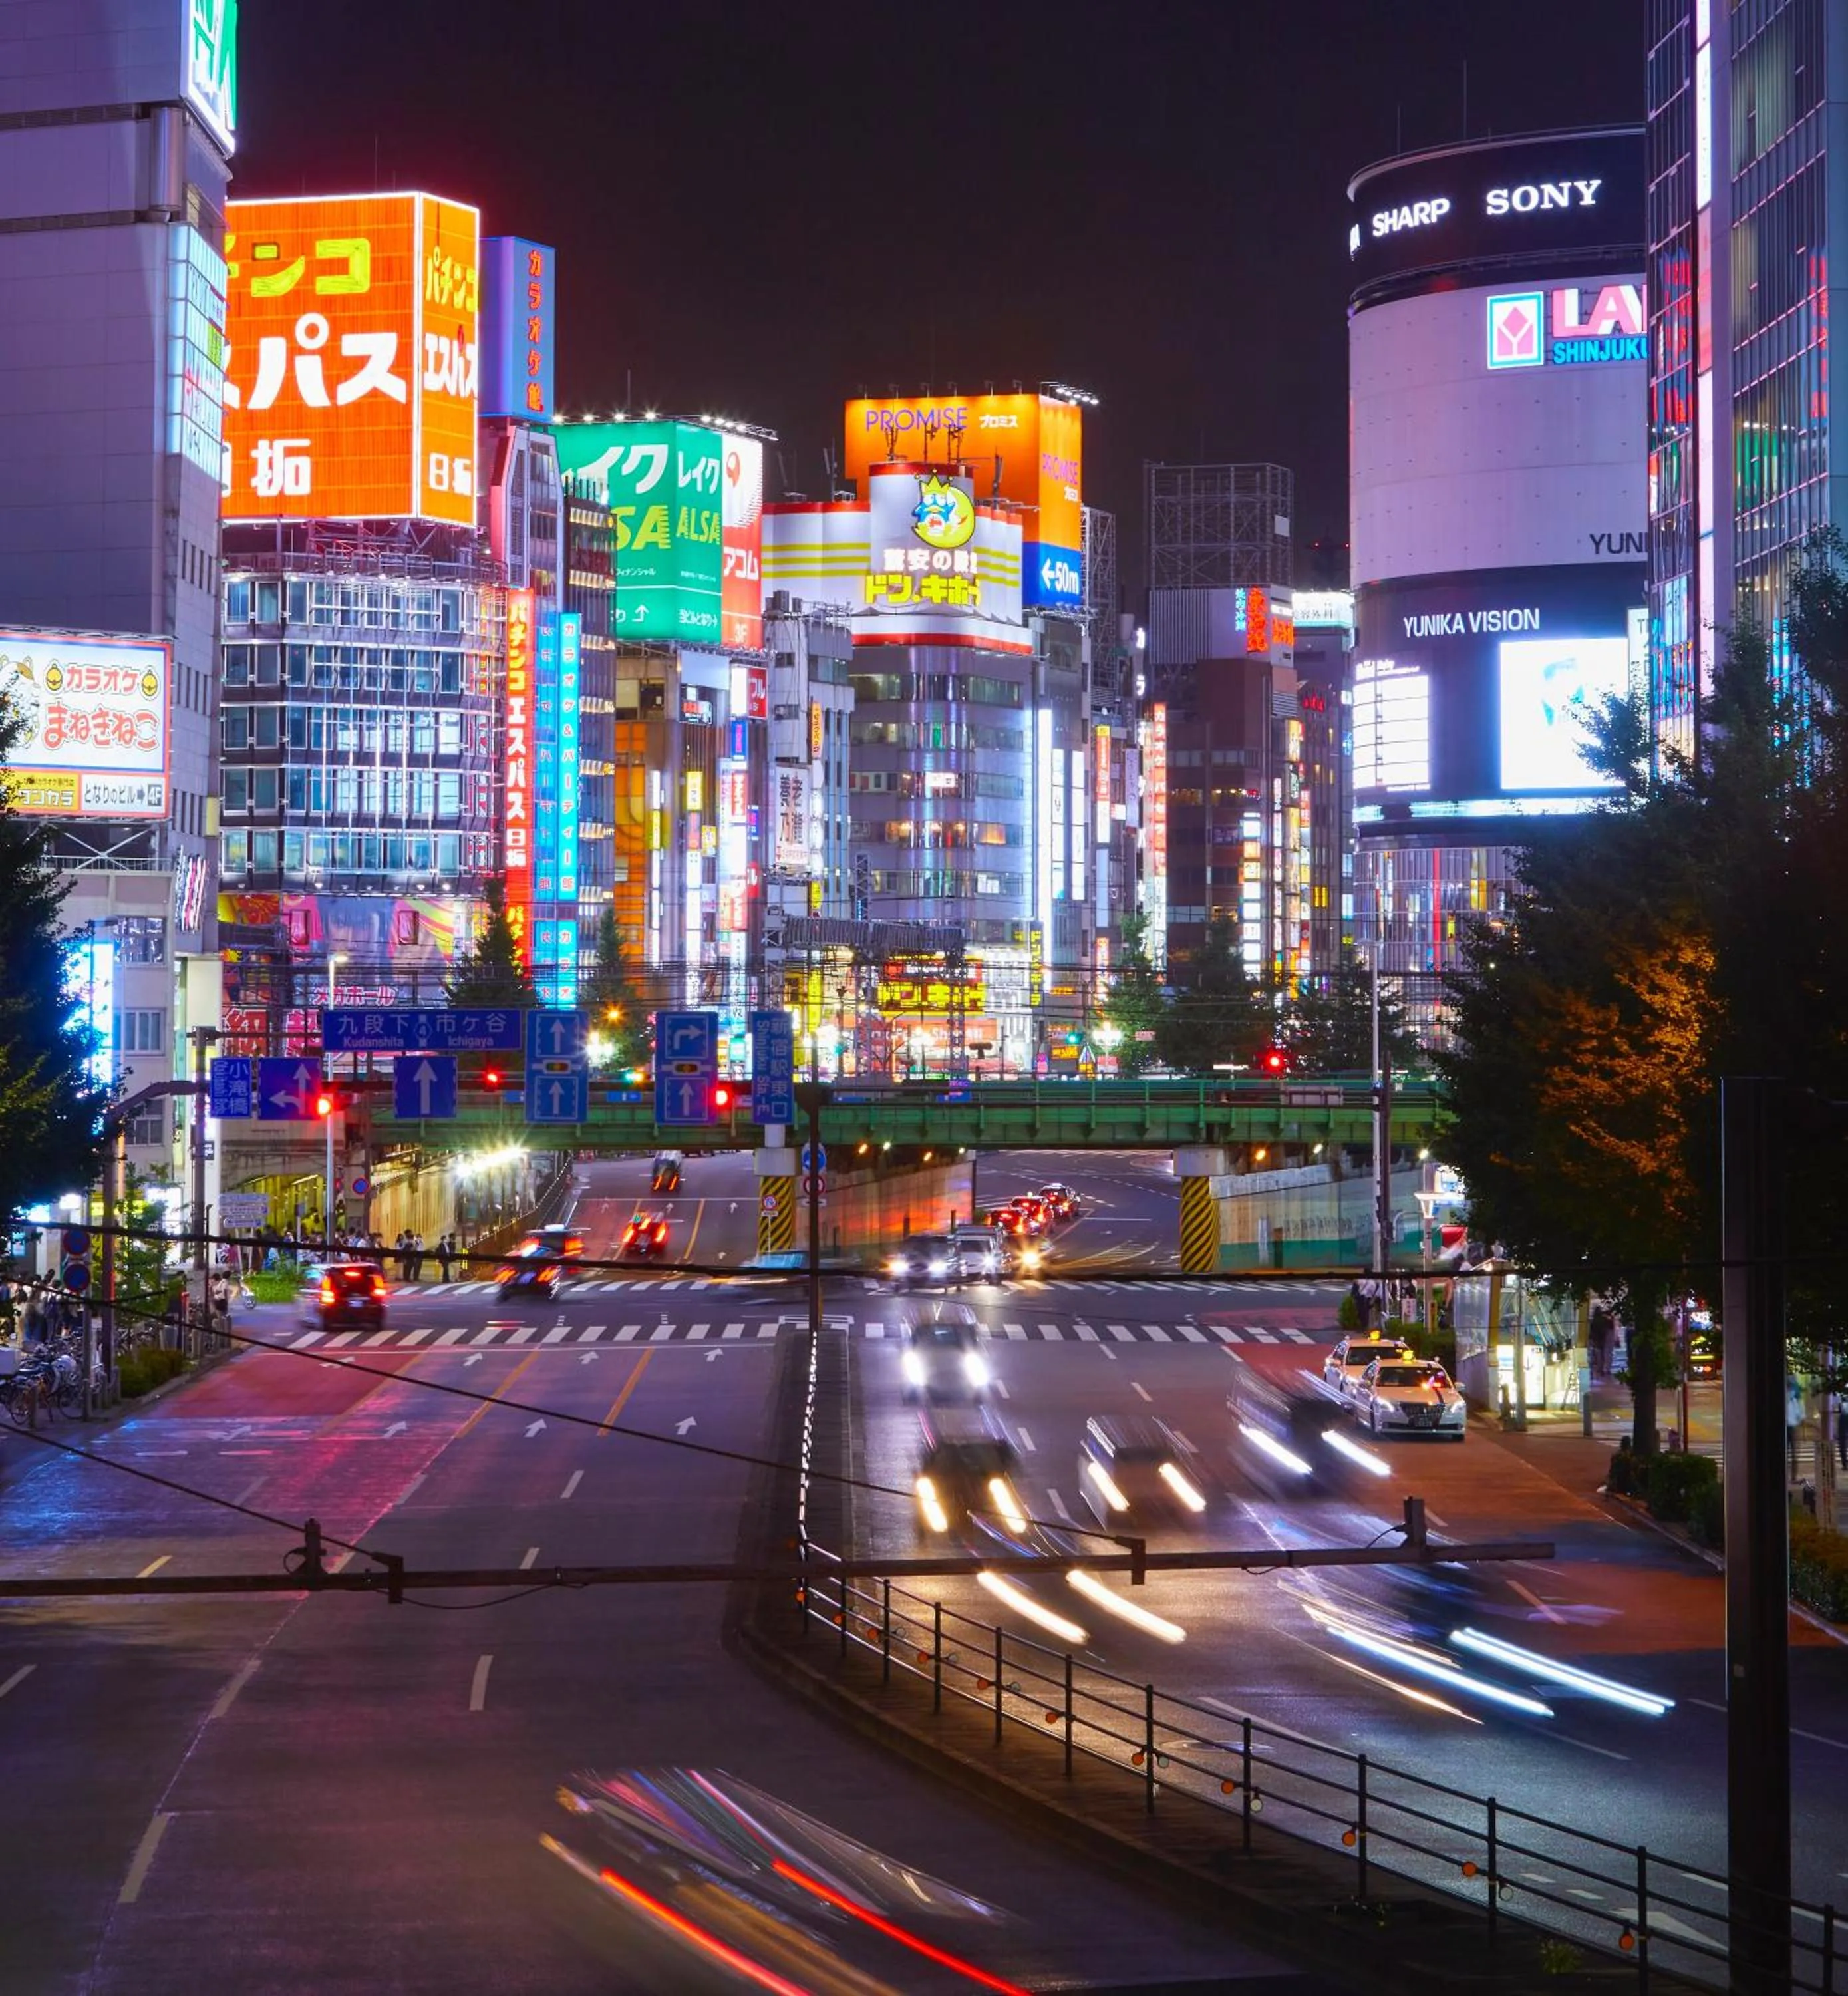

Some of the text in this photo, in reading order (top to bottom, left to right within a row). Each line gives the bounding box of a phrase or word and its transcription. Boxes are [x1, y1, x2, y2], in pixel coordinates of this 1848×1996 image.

[1372, 179, 1602, 237] SHARP SONY
[425, 245, 477, 313] パチンコ
[1551, 284, 1648, 337] LA
[424, 325, 477, 397] エスパス
[865, 407, 969, 432] PROMISE
[979, 415, 1020, 429] プロミス
[677, 450, 721, 494] レイク
[1042, 452, 1078, 486] PROMISE
[675, 506, 720, 545] ALSA
[724, 545, 759, 582] アコム
[1054, 560, 1080, 595] 50m
[1404, 608, 1541, 638] YUNIKA VISION
[508, 600, 527, 691] パチンコ
[66, 665, 140, 693] カラオケ
[43, 703, 159, 749] まねきねこ
[84, 784, 162, 806] となりのビル 4F
[507, 697, 527, 868] エスパス日拓
[338, 1013, 409, 1035] 九段下
[343, 1035, 404, 1048] Kudanshita
[448, 1035, 494, 1048] Ichigaya
[756, 1019, 770, 1071] Shinjuku
[770, 1017, 789, 1118] 新宿駅東口
[228, 1061, 249, 1114] 小滝橋
